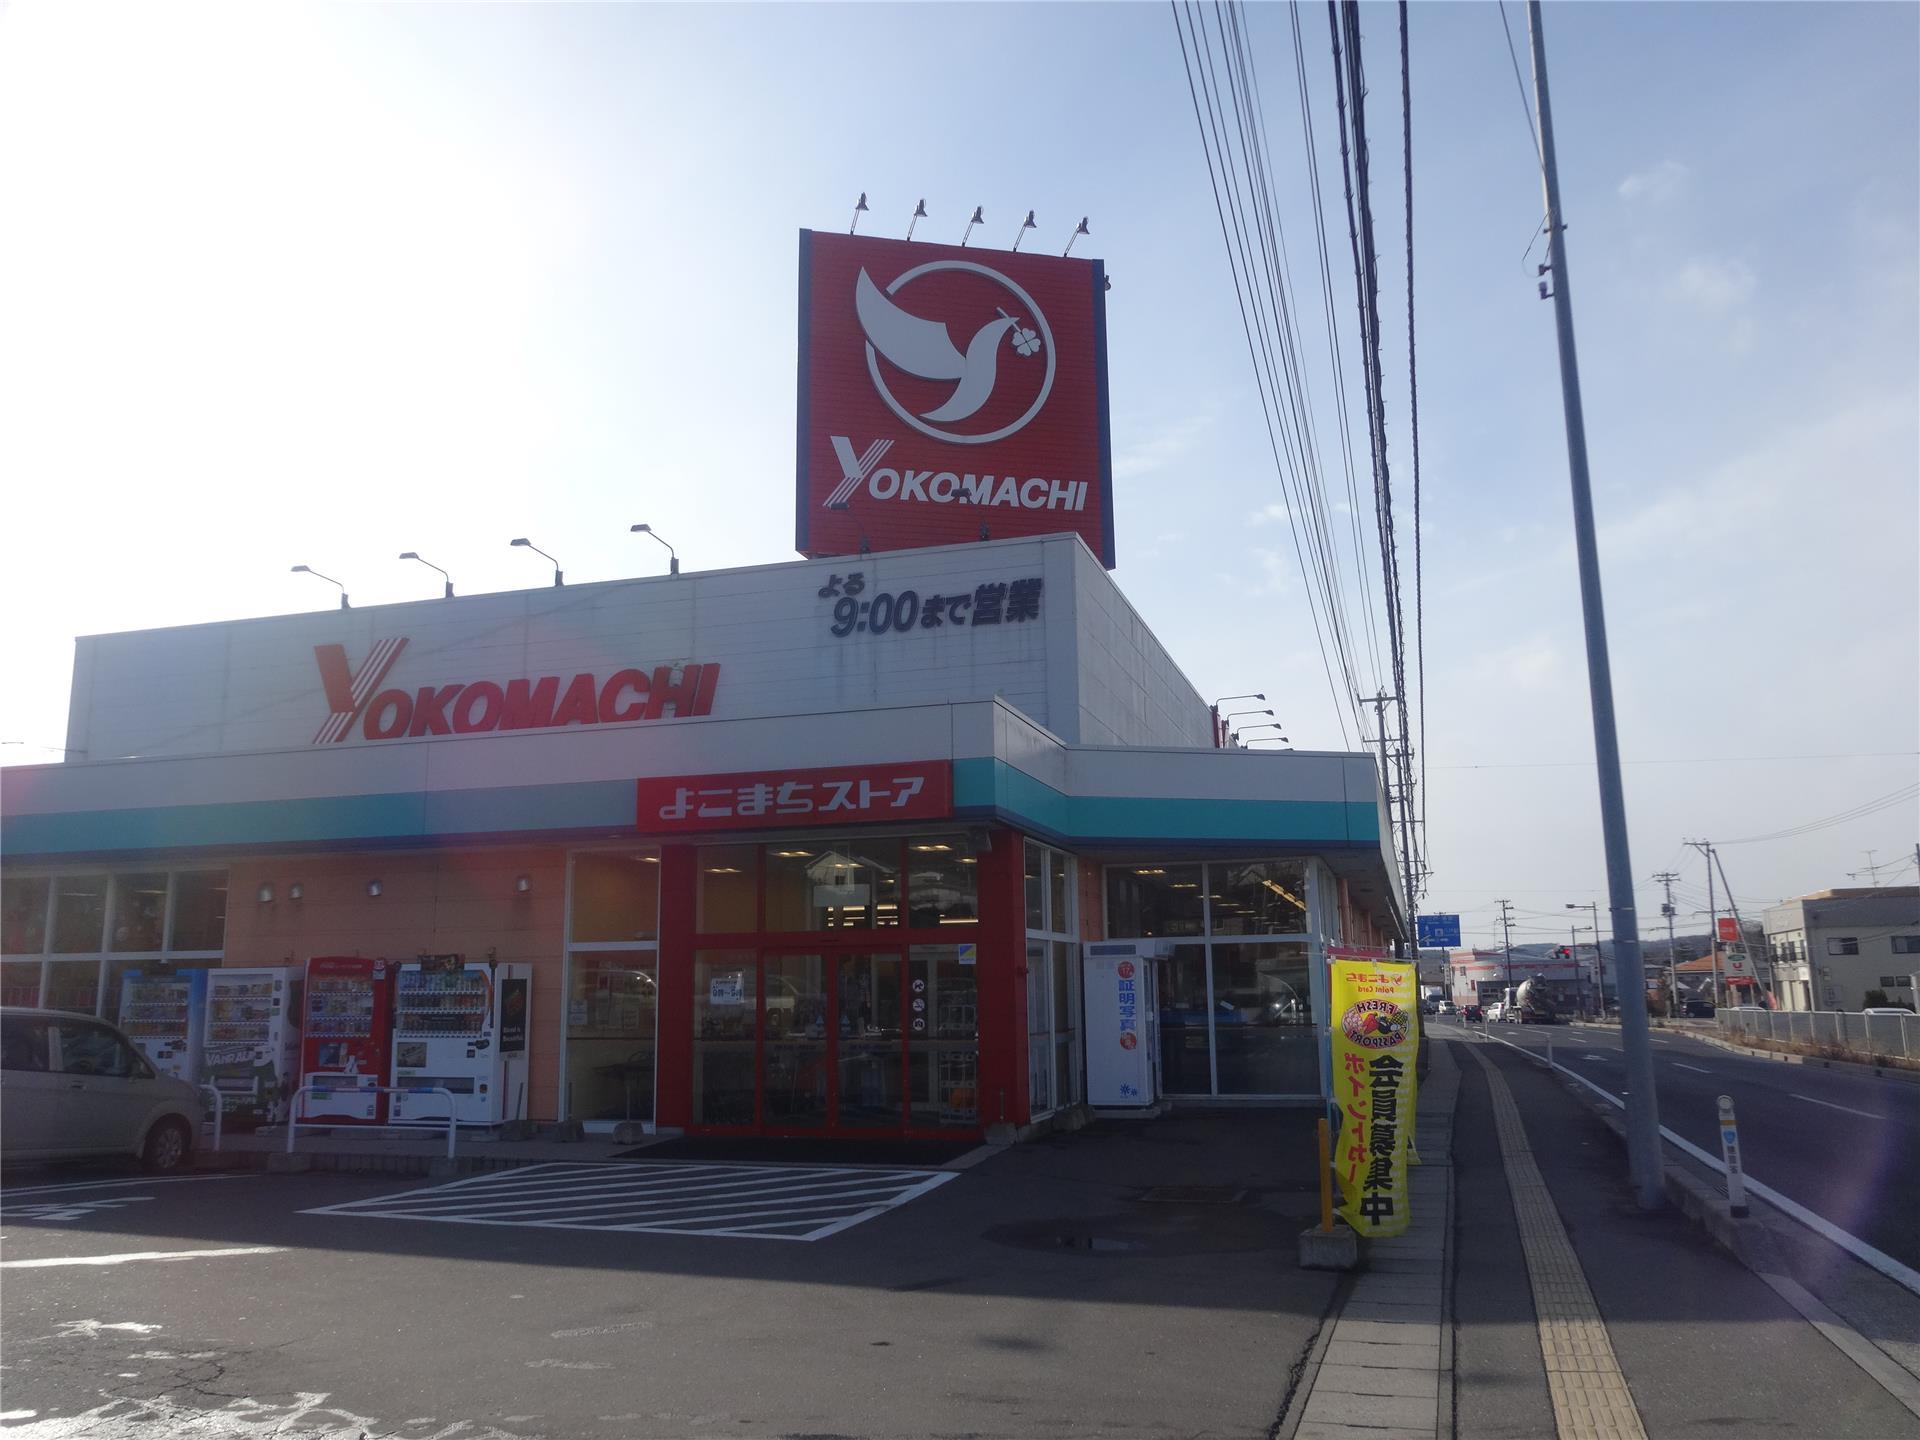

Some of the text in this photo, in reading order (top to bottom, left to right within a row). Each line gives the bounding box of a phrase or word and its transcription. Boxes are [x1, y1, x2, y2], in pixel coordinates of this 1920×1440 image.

[823, 435, 1088, 511] YOKOMACHI
[818, 571, 866, 599] よる
[831, 577, 1044, 637] 9:00まで営業
[313, 636, 720, 743] YOKOMACHI
[658, 775, 925, 820] よこまちストア
[1118, 979, 1137, 1031] 証明写真
